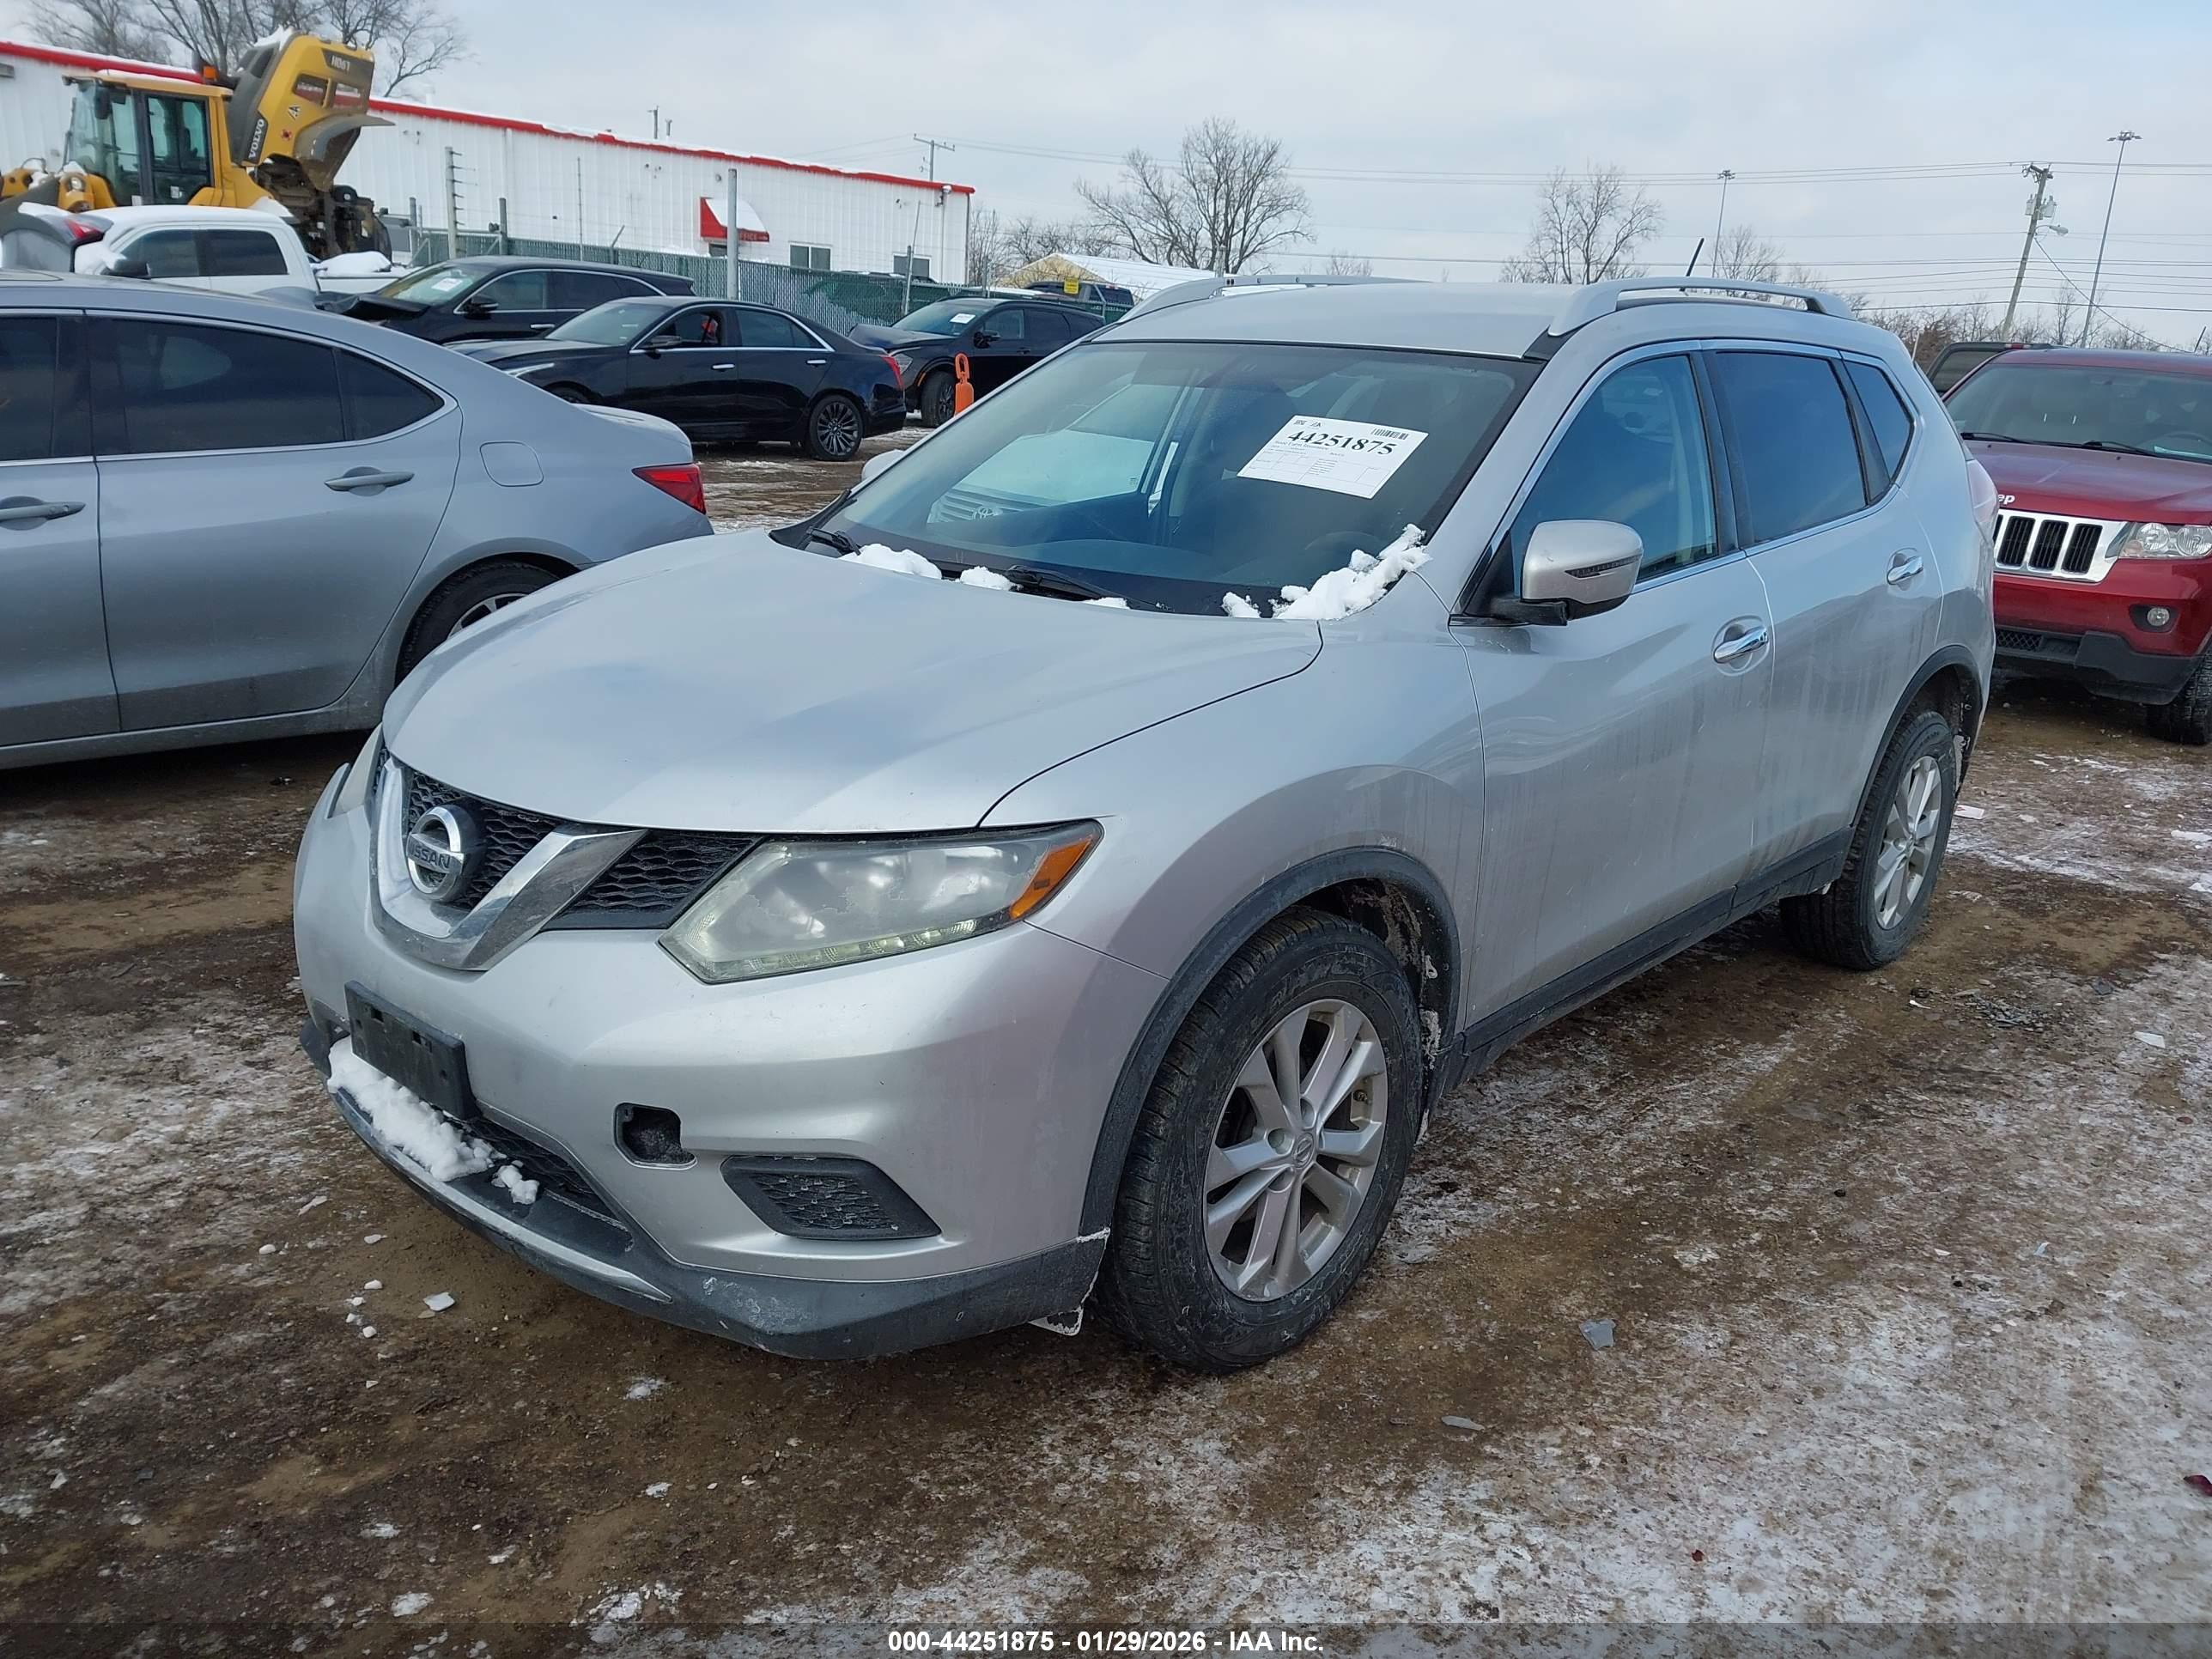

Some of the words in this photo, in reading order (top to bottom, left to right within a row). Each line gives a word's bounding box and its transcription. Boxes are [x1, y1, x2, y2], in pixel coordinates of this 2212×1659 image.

[248, 118, 264, 159] VOLVO
[1287, 430, 1397, 456] 44251875
[1997, 494, 2015, 505] ep
